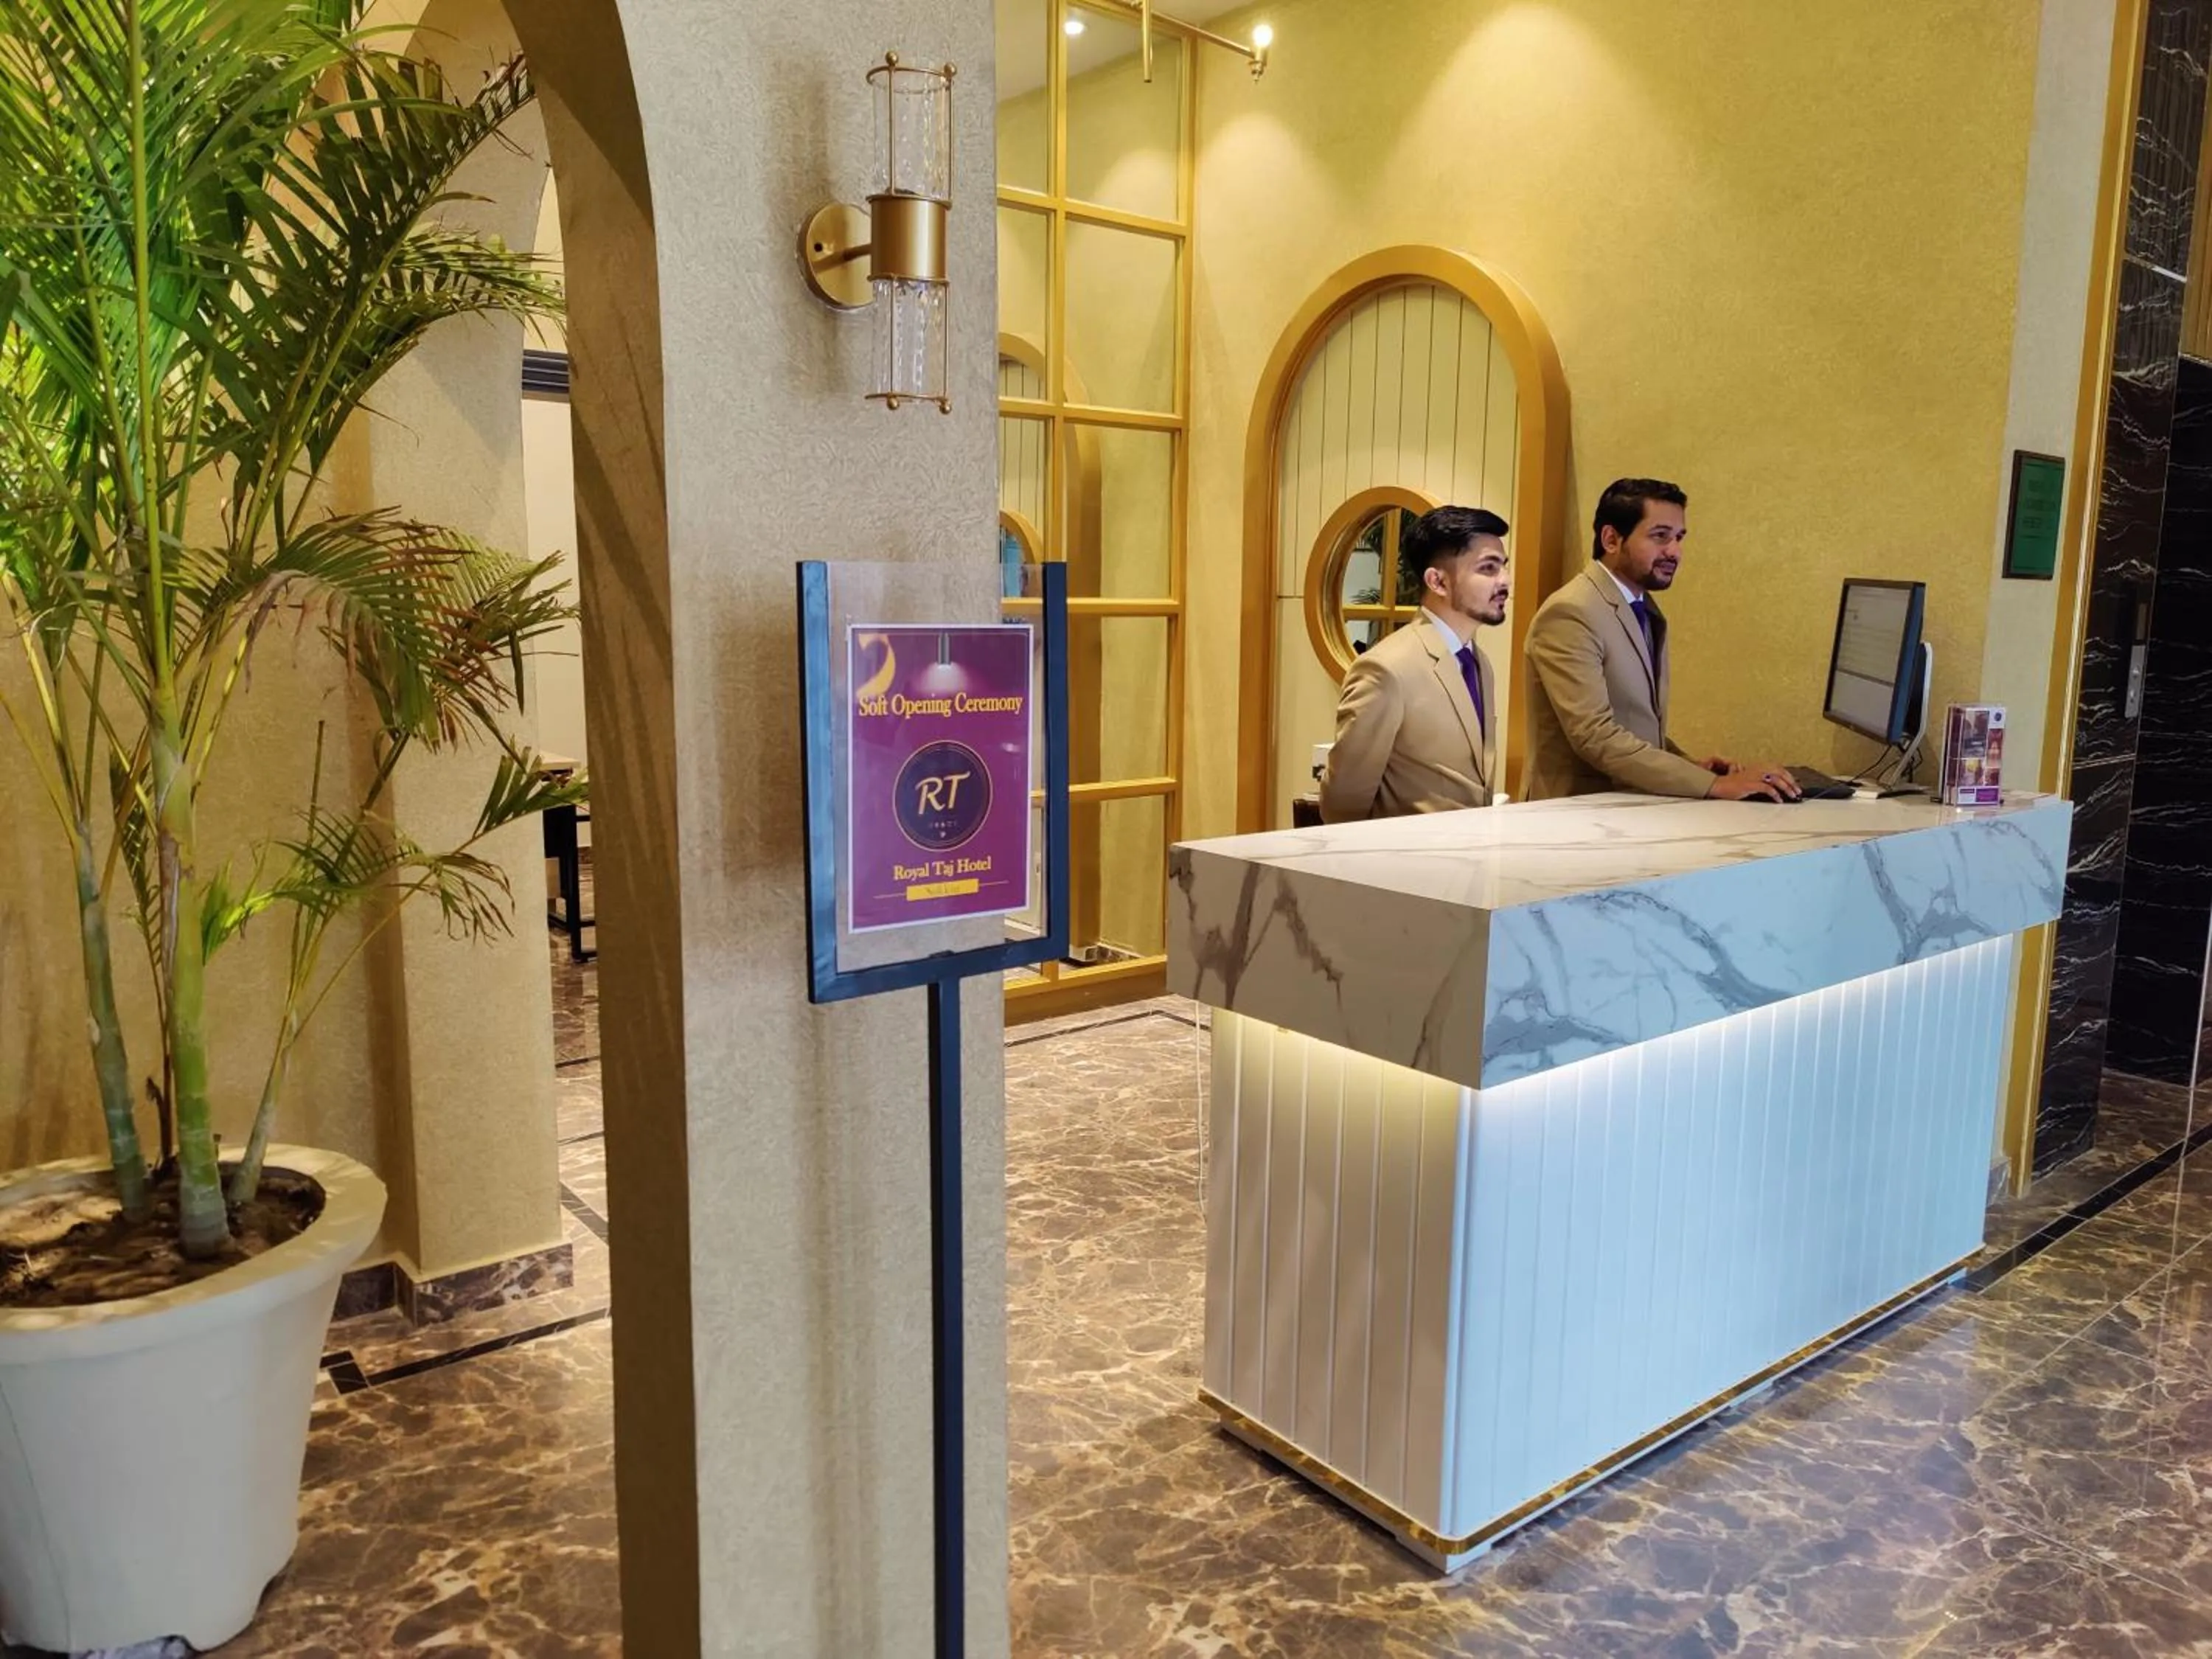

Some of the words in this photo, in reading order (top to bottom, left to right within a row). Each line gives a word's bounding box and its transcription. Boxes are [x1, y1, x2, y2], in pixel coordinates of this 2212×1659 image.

[859, 695, 888, 716] Soft
[891, 693, 952, 719] Opening
[955, 692, 1023, 714] Ceremony
[915, 771, 970, 815] RT
[894, 862, 929, 880] Royal
[957, 855, 991, 873] Hotel
